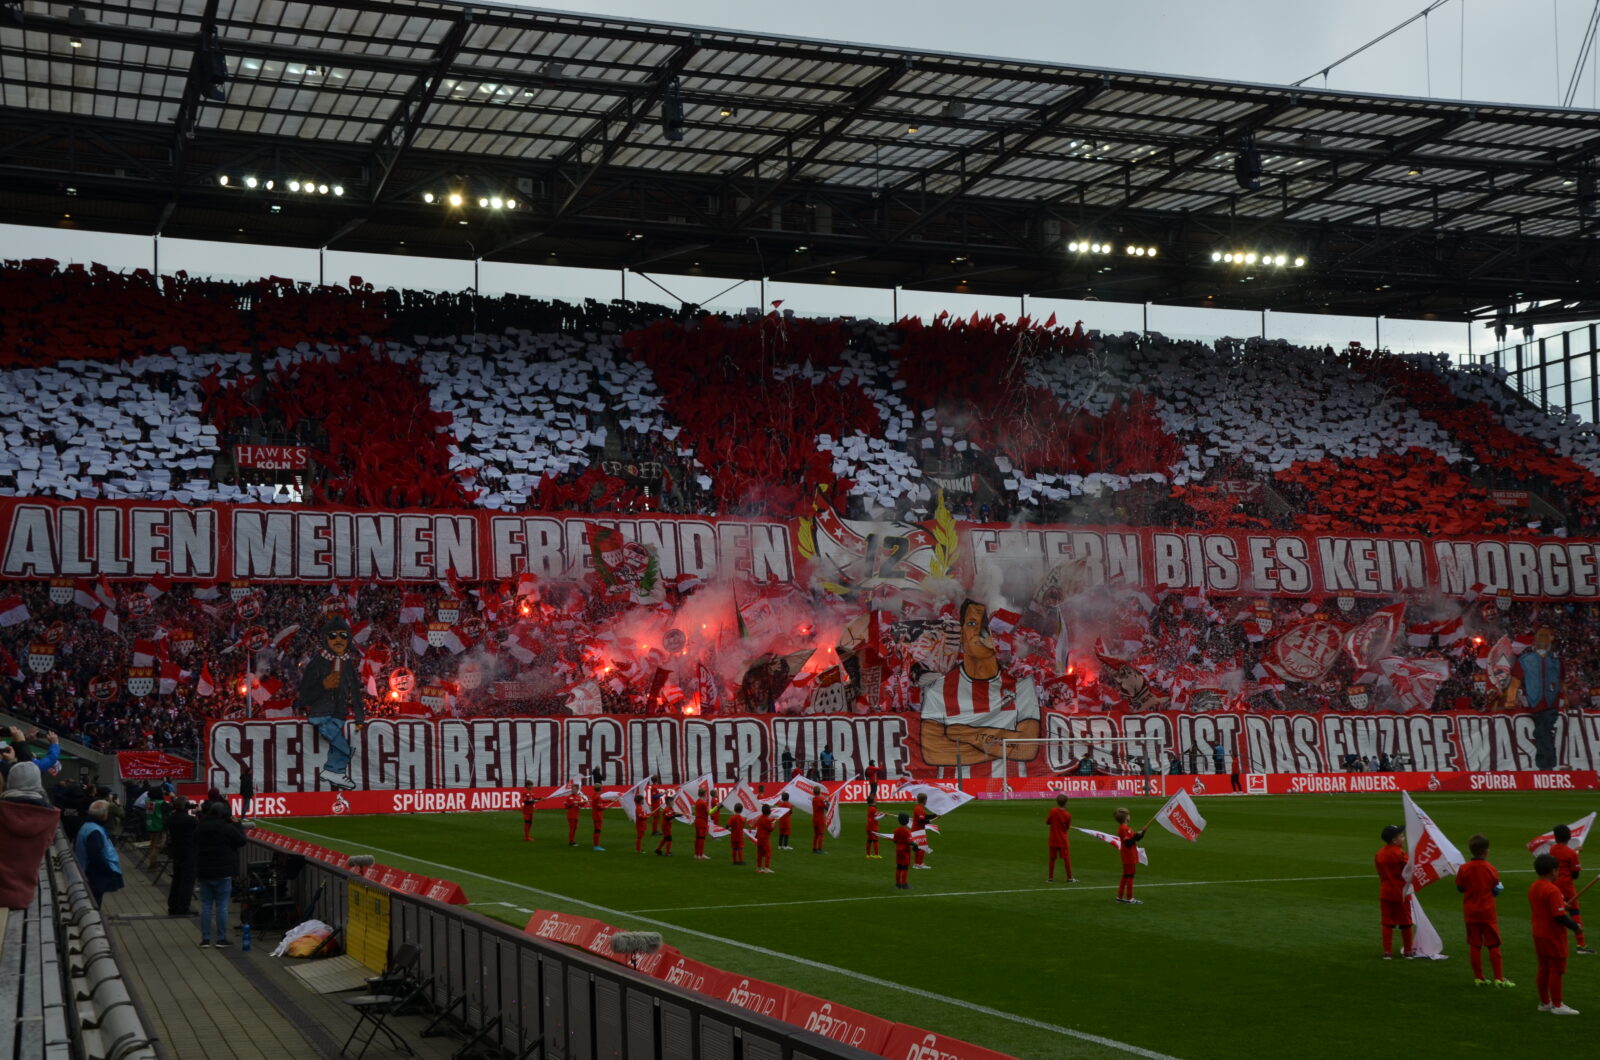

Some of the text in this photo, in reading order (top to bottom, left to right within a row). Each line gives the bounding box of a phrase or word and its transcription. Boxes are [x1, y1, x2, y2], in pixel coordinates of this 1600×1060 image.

[237, 446, 306, 464] HAWKS
[256, 460, 291, 470] KÖLN
[2, 505, 217, 578] ALLEN
[232, 508, 478, 581] MEINEN
[491, 516, 794, 585] FRENDEN
[1152, 532, 1239, 591] BIS
[1248, 535, 1312, 594] ES
[1317, 536, 1427, 594] KEIN
[1433, 540, 1600, 597] MORGE
[209, 718, 335, 792] STEH
[345, 718, 435, 790] ICH
[440, 718, 560, 788] BEIM
[564, 717, 624, 785] FC
[628, 717, 682, 784] IN
[684, 716, 771, 784] DER
[772, 716, 911, 782] KURVE
[1046, 712, 1119, 775] DER
[1122, 713, 1174, 775] FC
[1178, 714, 1242, 774] IST
[1244, 714, 1323, 773] DAS
[1324, 714, 1457, 772] EINZIGE
[1457, 713, 1537, 771] WAS
[1291, 774, 1400, 792] SPÜRBAR ANDERS.
[1470, 772, 1575, 790] SPÜRBA NDERS.
[393, 790, 466, 811] SPÜRBAR
[536, 919, 581, 942] DERTOUR
[665, 965, 705, 991] DERTOUR
[727, 987, 776, 1016] DERTOUR
[804, 1010, 866, 1048] DERTOUR
